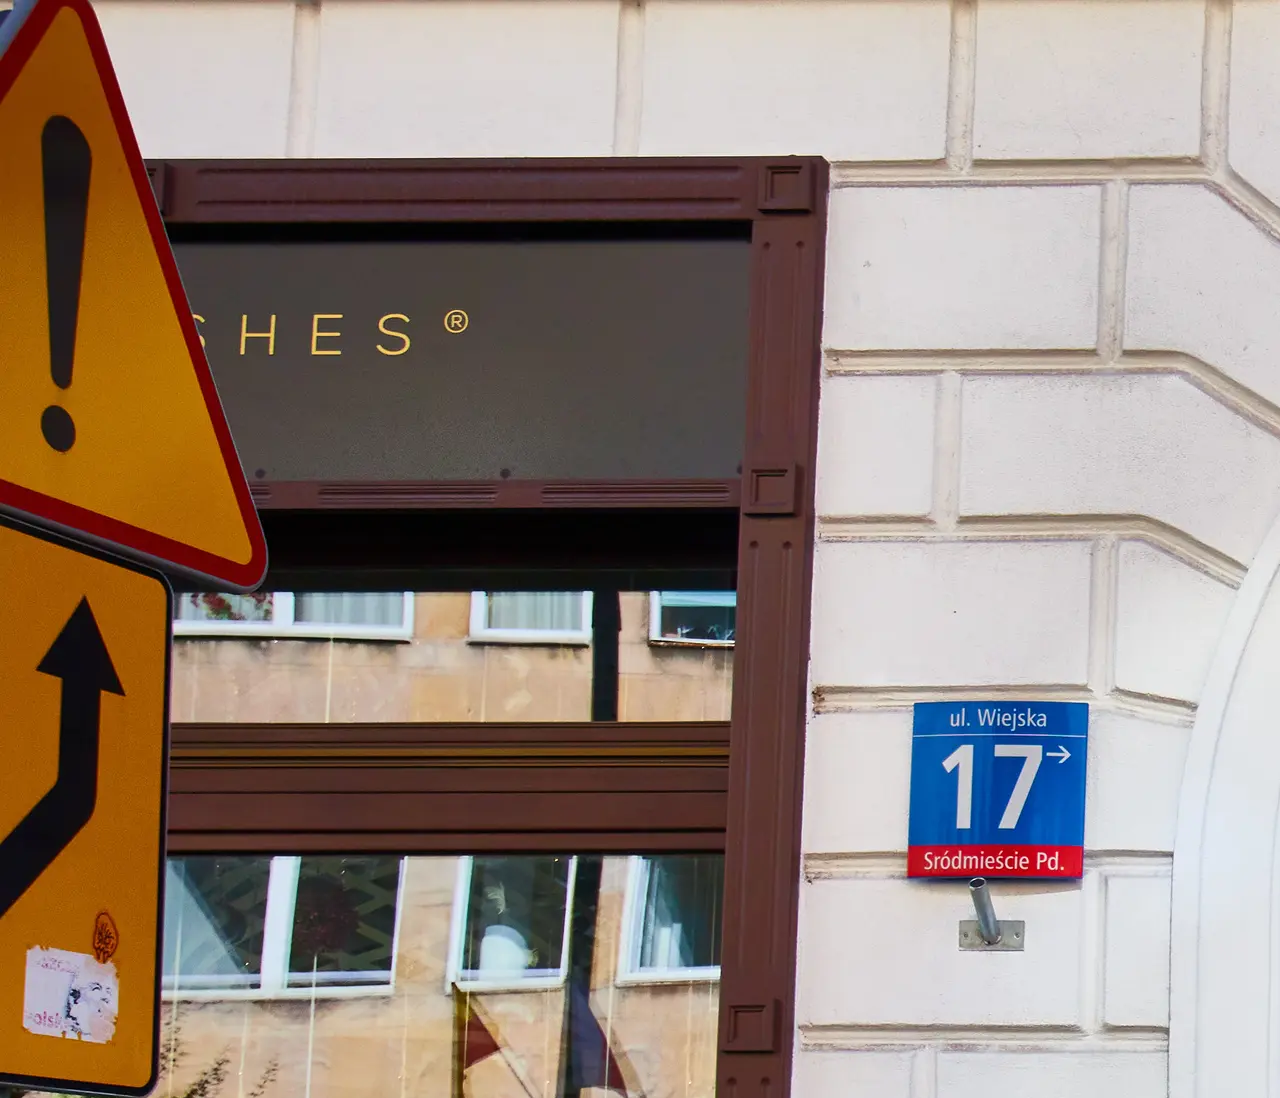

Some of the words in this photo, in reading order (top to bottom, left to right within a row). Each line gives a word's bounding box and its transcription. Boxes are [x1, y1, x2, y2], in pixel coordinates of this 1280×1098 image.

[950, 707, 971, 727] ul.
[977, 707, 1048, 732] Wiejska
[941, 744, 1043, 829] 17
[1036, 851, 1065, 871] Pd.
